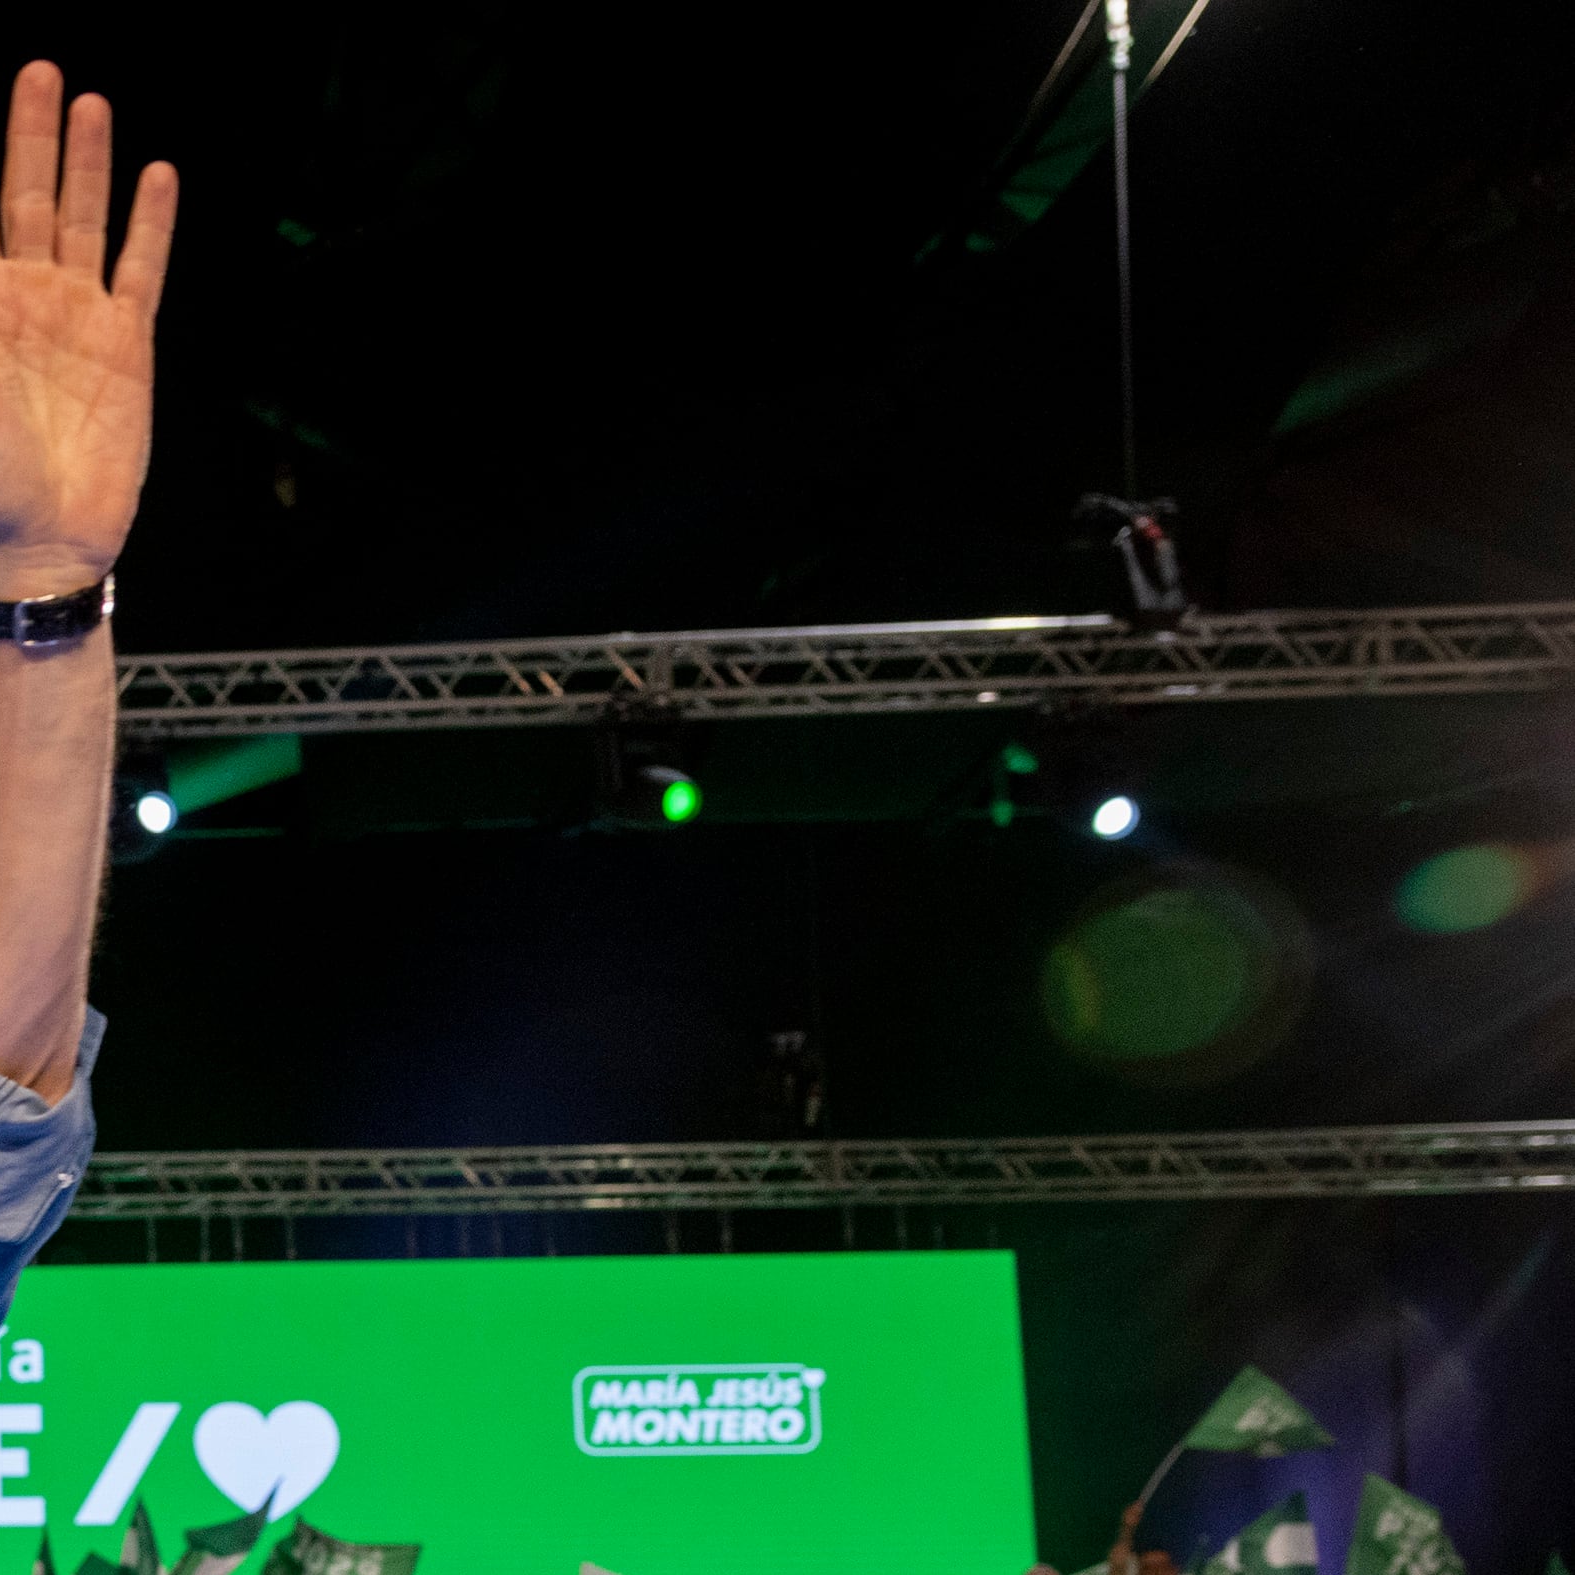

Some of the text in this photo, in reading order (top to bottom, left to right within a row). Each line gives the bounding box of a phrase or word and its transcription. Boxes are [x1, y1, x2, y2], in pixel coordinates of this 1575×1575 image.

[589, 1372, 804, 1409] MARÍA JESÚS
[591, 1407, 805, 1444] MONTERO
